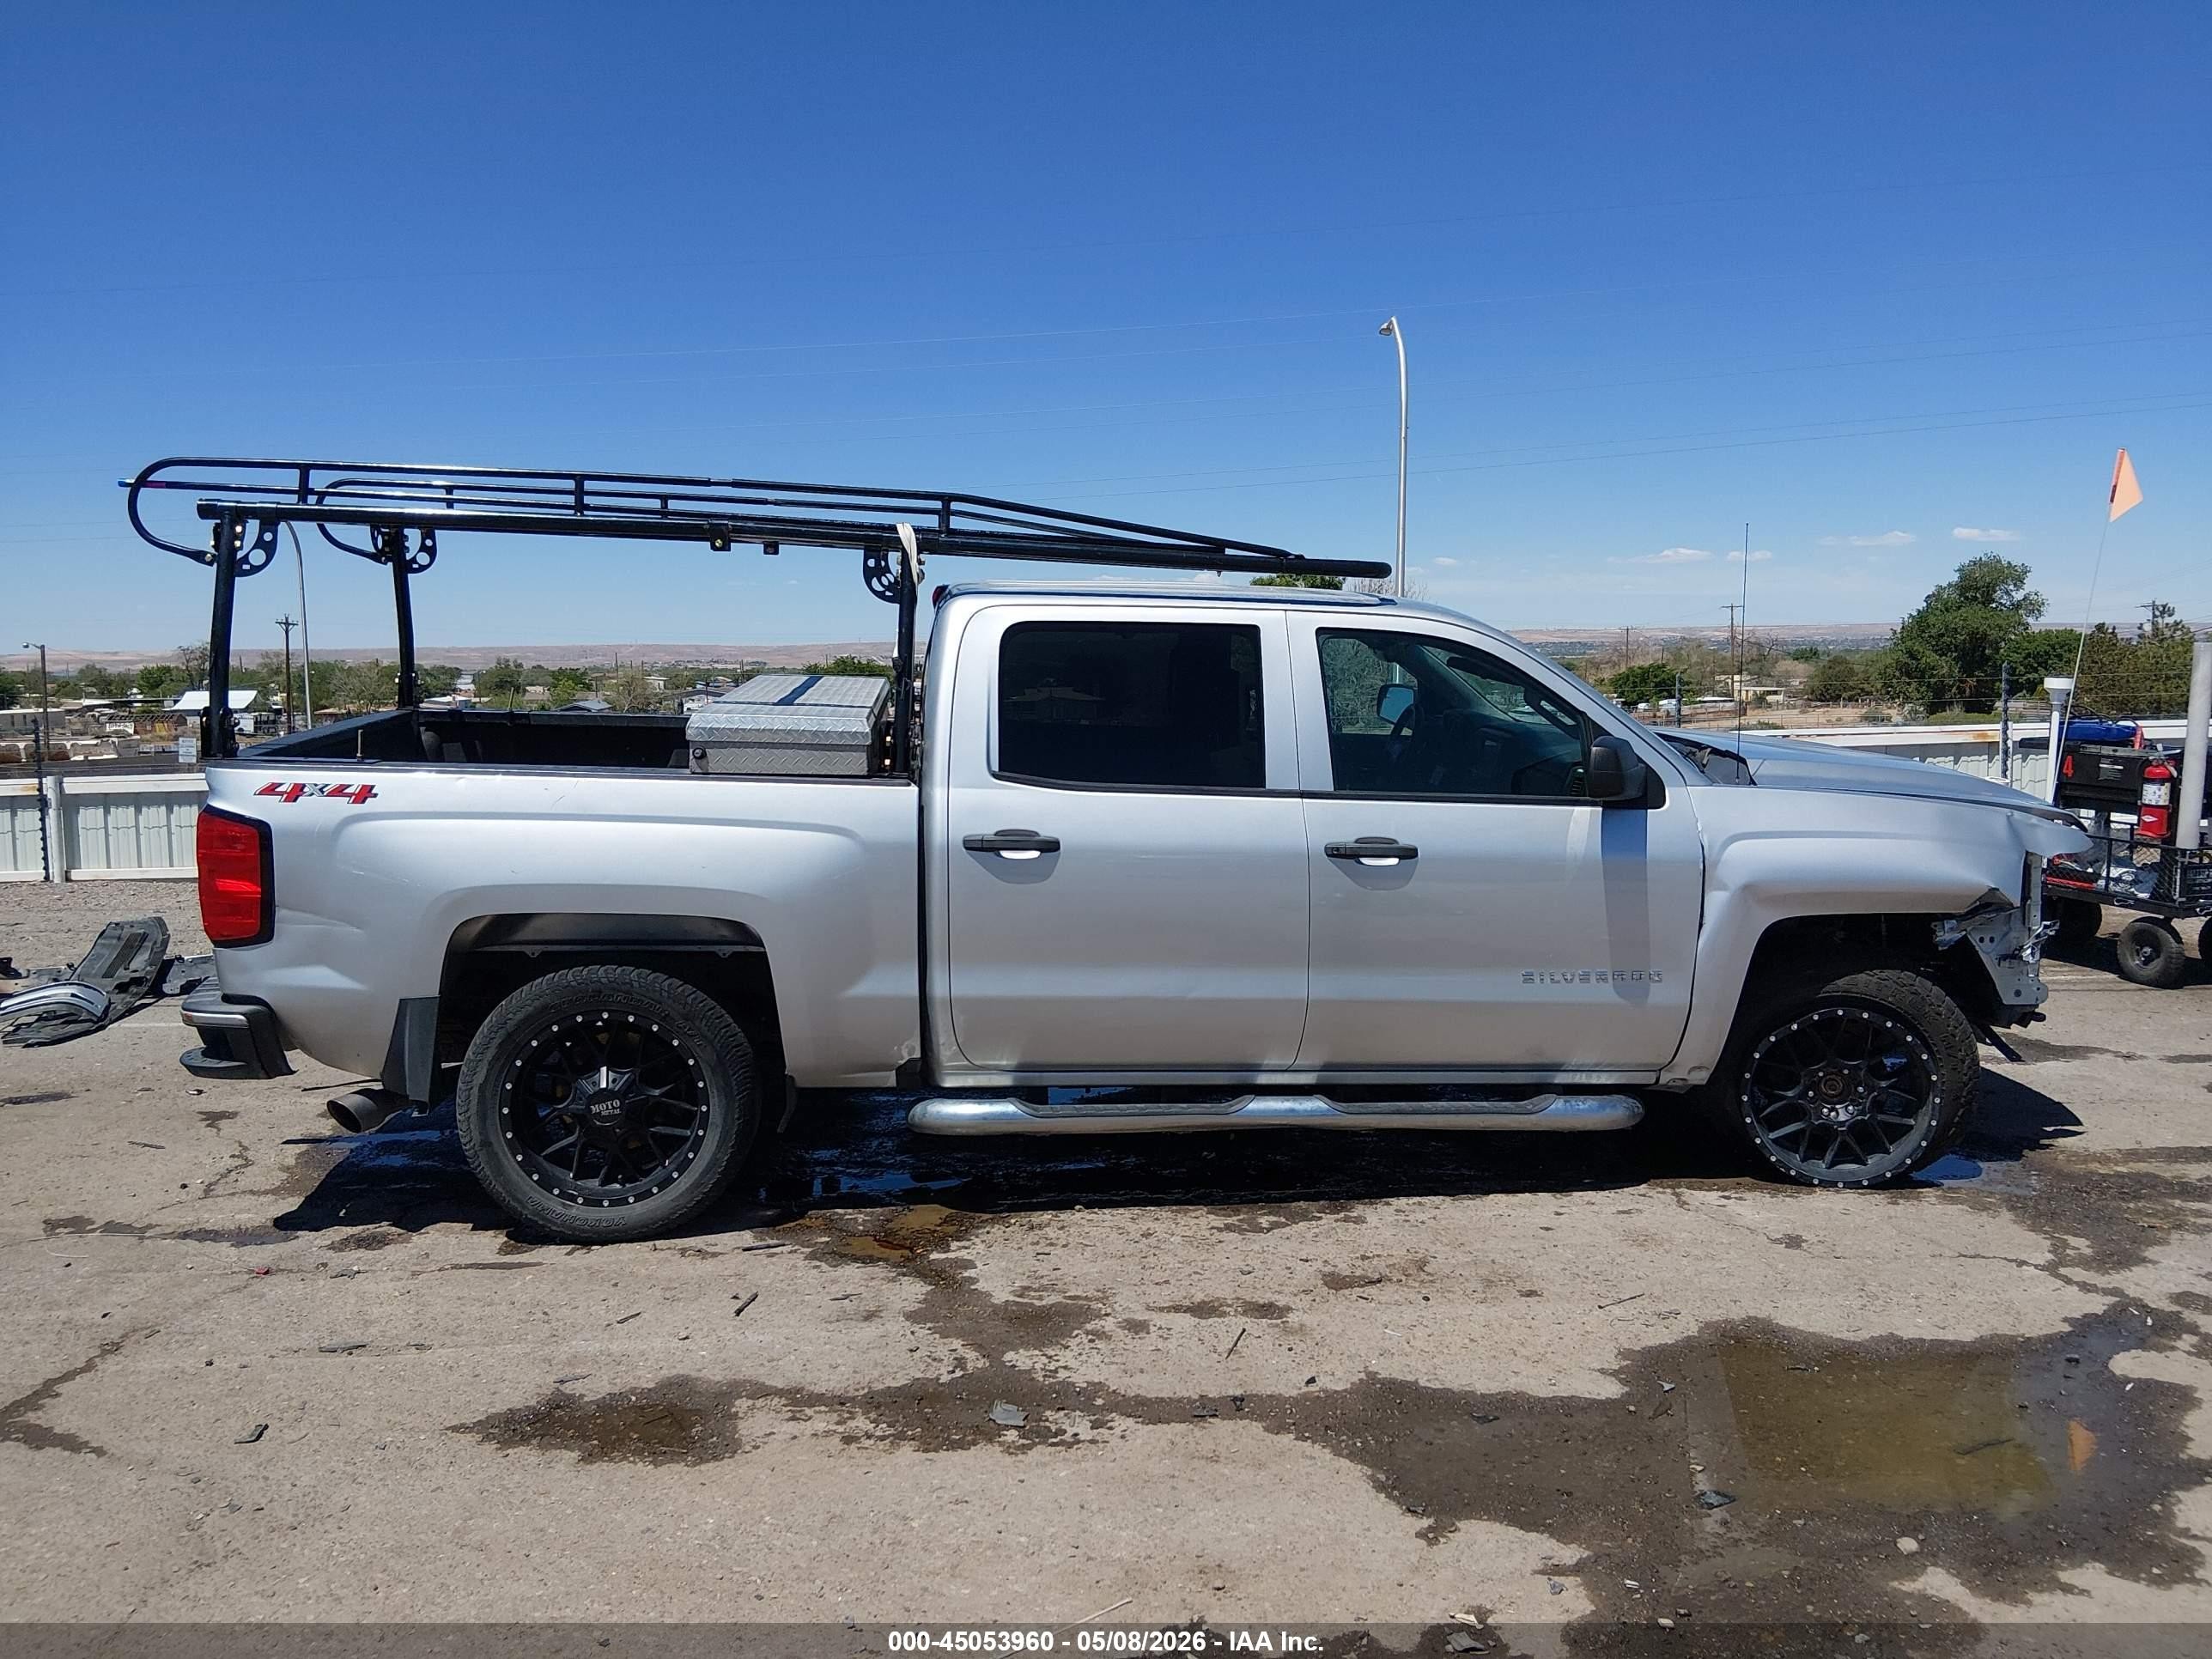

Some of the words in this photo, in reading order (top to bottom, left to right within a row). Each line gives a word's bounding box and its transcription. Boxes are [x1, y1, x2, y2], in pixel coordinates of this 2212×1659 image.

[2063, 755, 2074, 778] 4
[1521, 969, 1663, 984] SILVERADO
[590, 1099, 620, 1115] MOTO
[525, 1195, 627, 1228] YOKOHAMA
